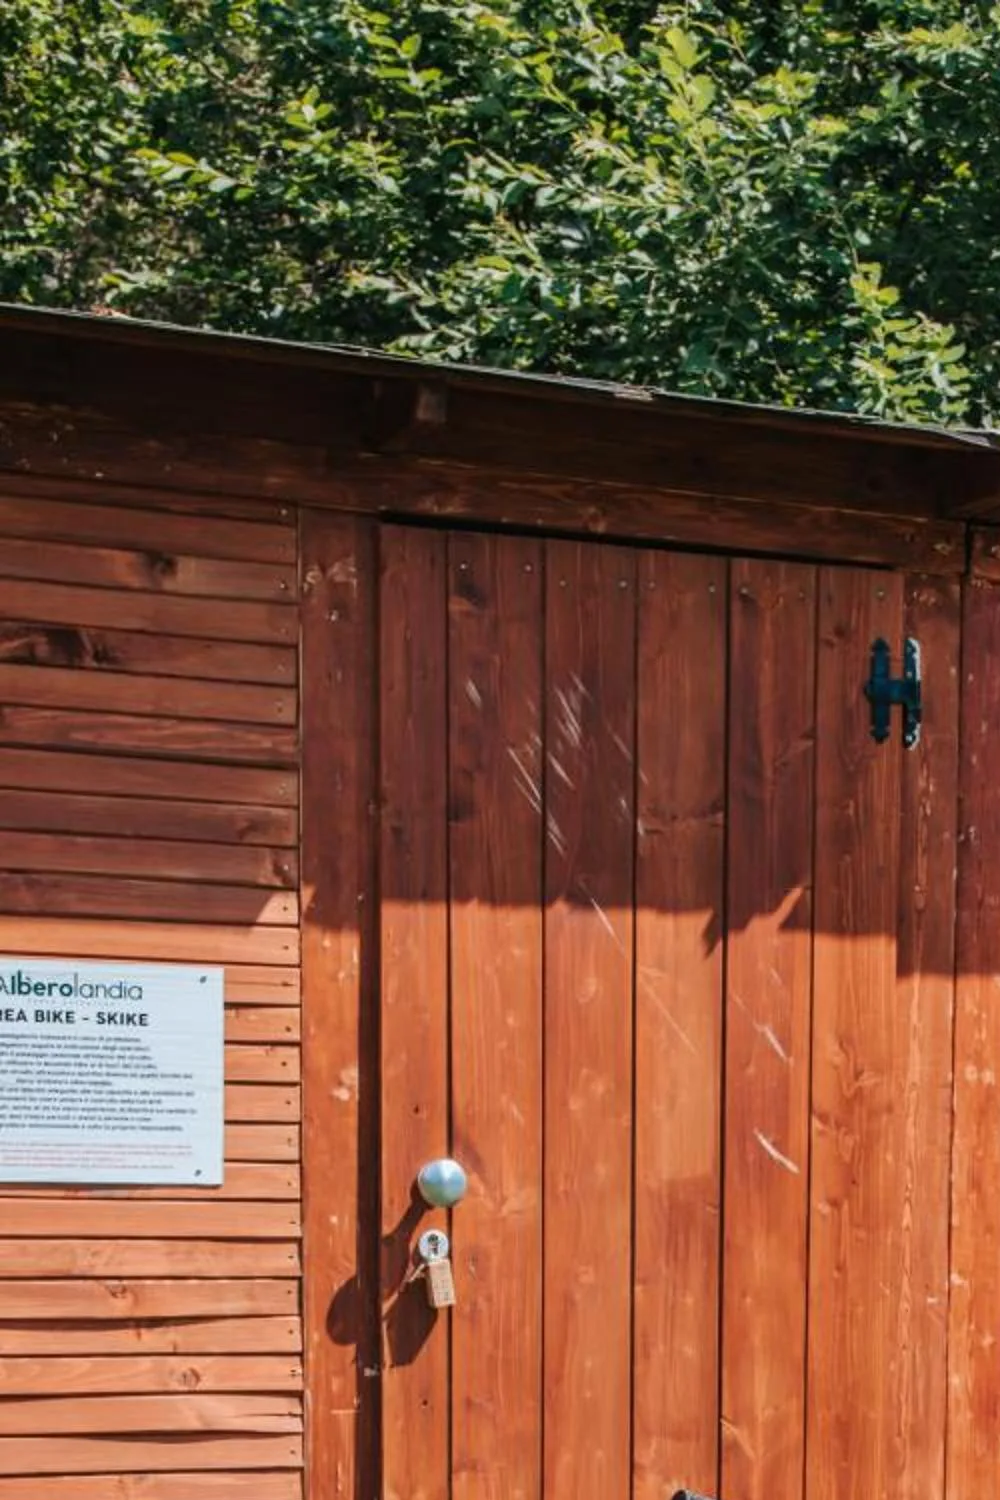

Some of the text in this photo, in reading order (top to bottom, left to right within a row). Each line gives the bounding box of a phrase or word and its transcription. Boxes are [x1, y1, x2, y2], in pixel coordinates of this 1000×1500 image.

[0, 1008, 28, 1022] EA
[34, 1009, 76, 1024] BIKE
[96, 1011, 149, 1027] SKIKE
